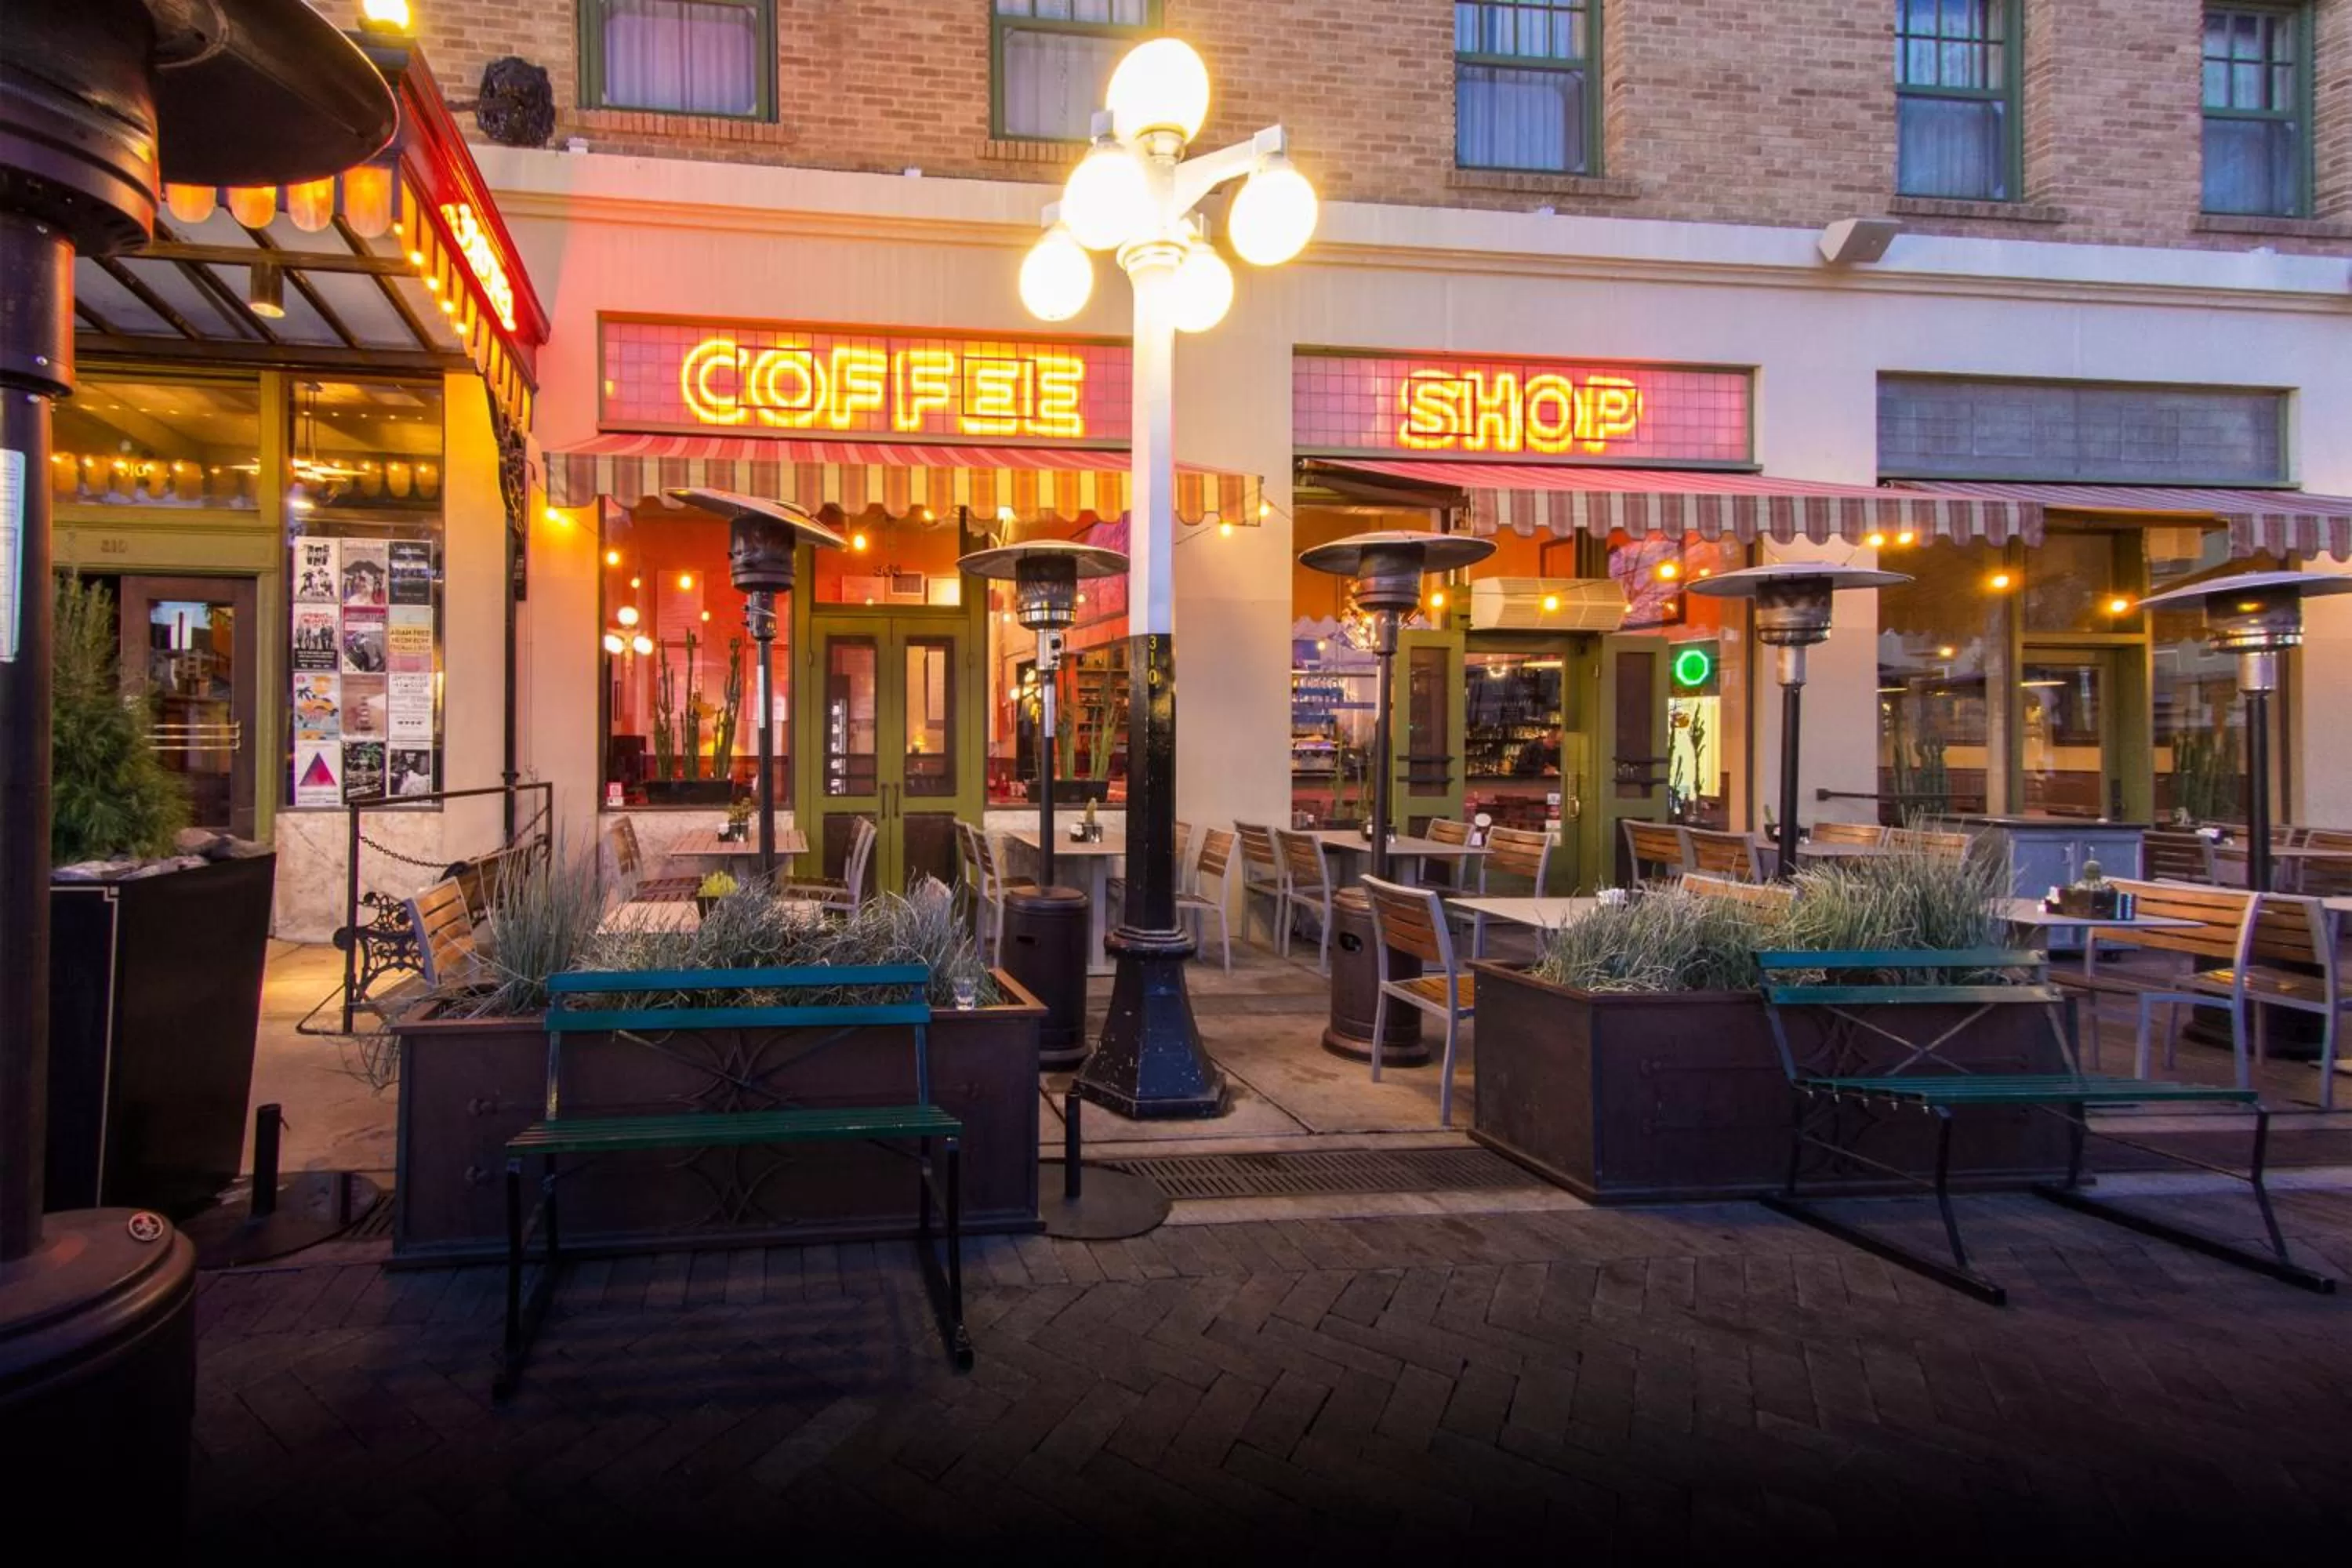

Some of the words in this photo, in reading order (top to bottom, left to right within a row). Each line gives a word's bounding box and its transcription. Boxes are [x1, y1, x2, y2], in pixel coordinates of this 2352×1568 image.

[681, 338, 1083, 437] COFFEE
[1399, 369, 1642, 452] SHOP
[1148, 635, 1158, 684] 310
